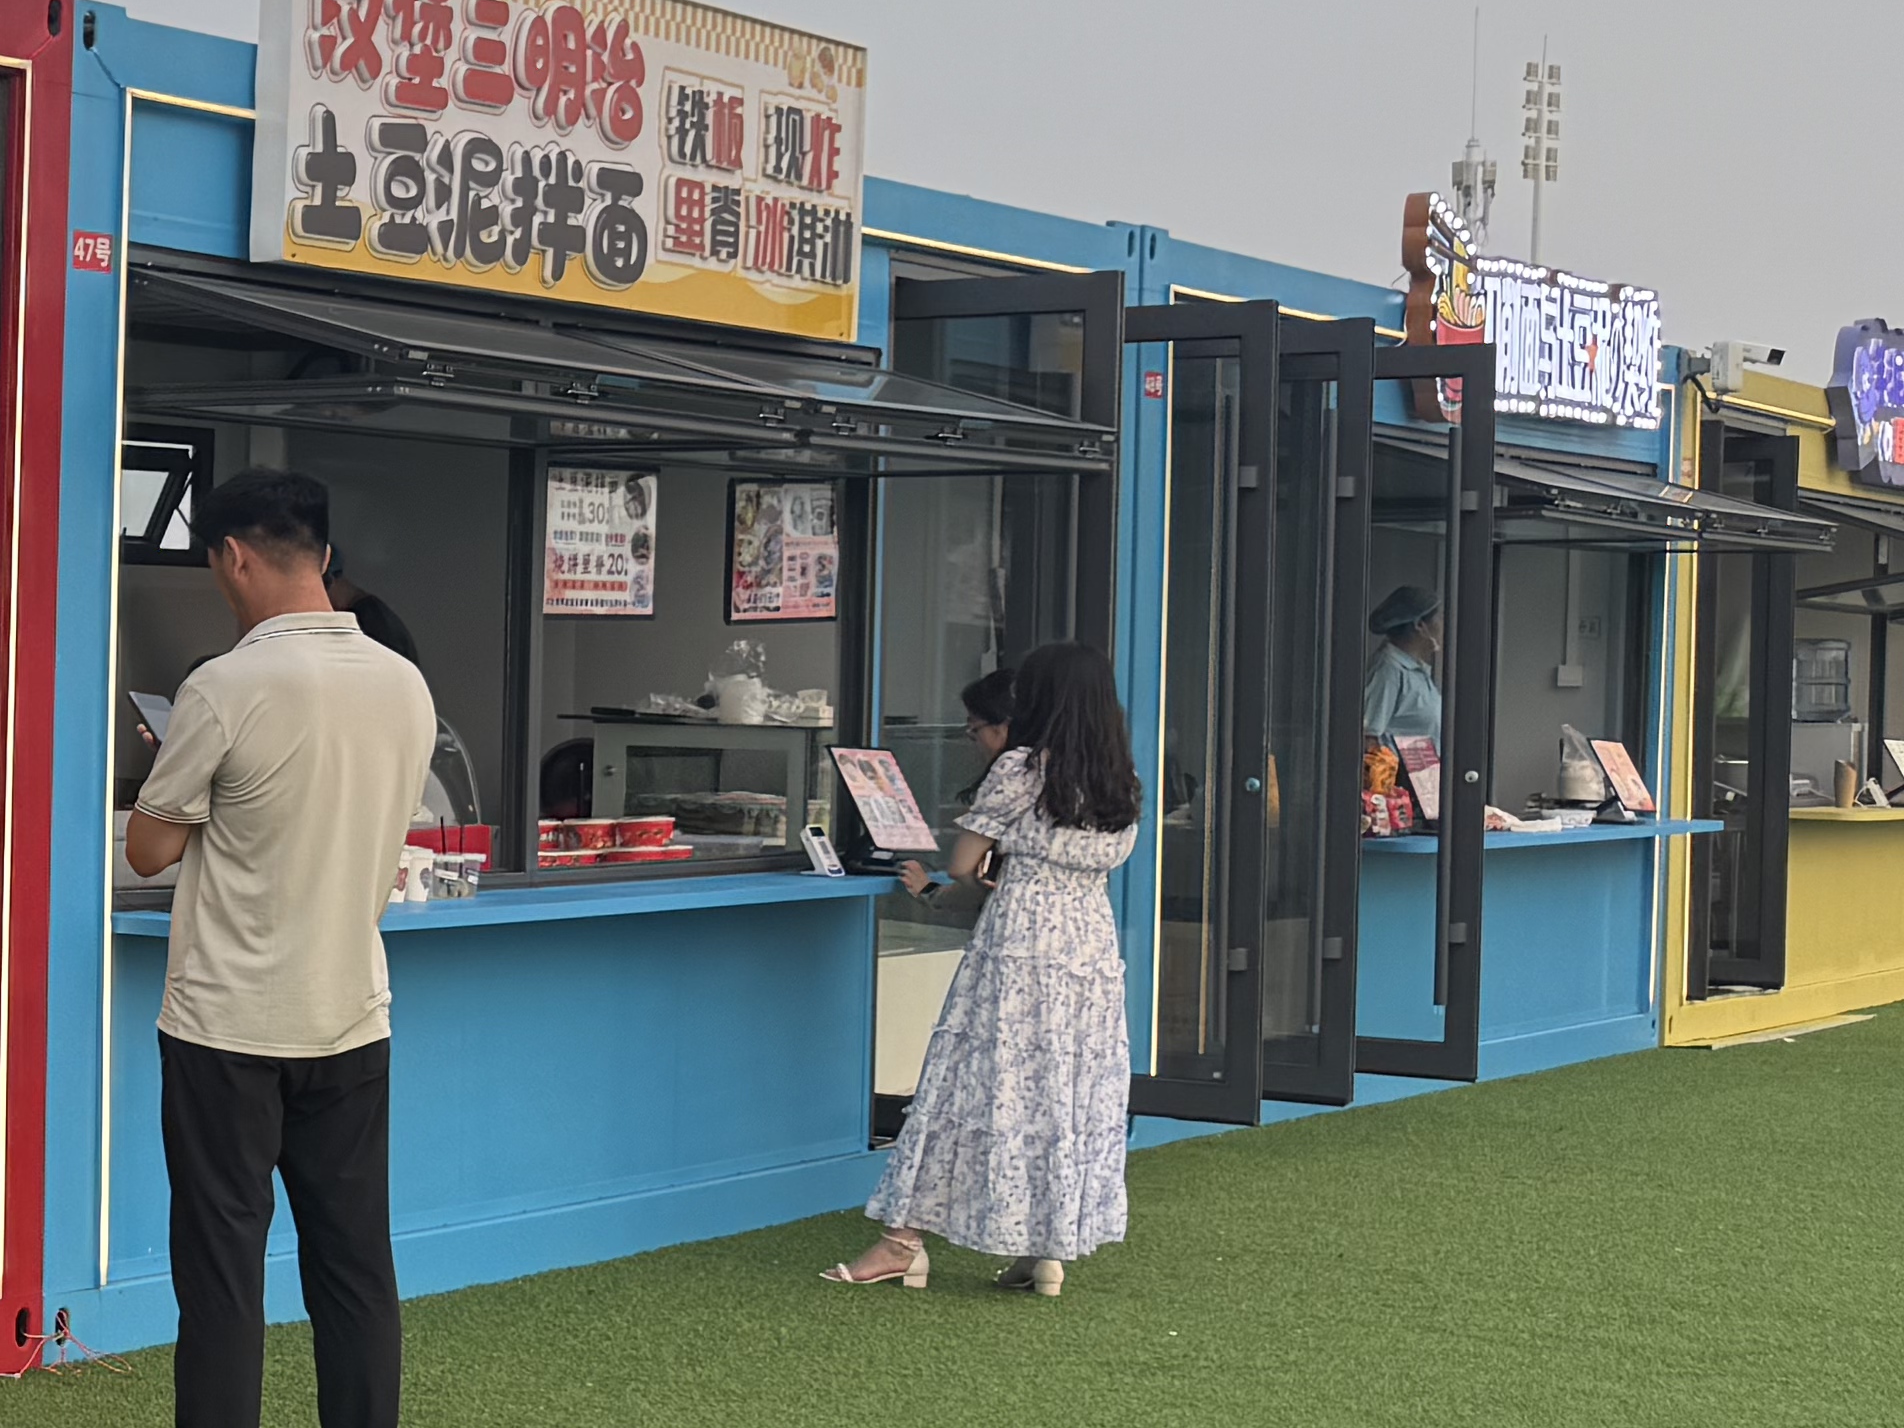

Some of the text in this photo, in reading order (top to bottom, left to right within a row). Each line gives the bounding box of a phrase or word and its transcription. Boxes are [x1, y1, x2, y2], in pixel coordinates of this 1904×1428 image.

[665, 79, 745, 171] 铁板
[762, 95, 841, 195] 现炸
[289, 103, 648, 290] 土豆泥拌面
[663, 177, 741, 261] 里脊
[742, 194, 853, 286] 冰淇淋
[74, 237, 112, 267] 47号
